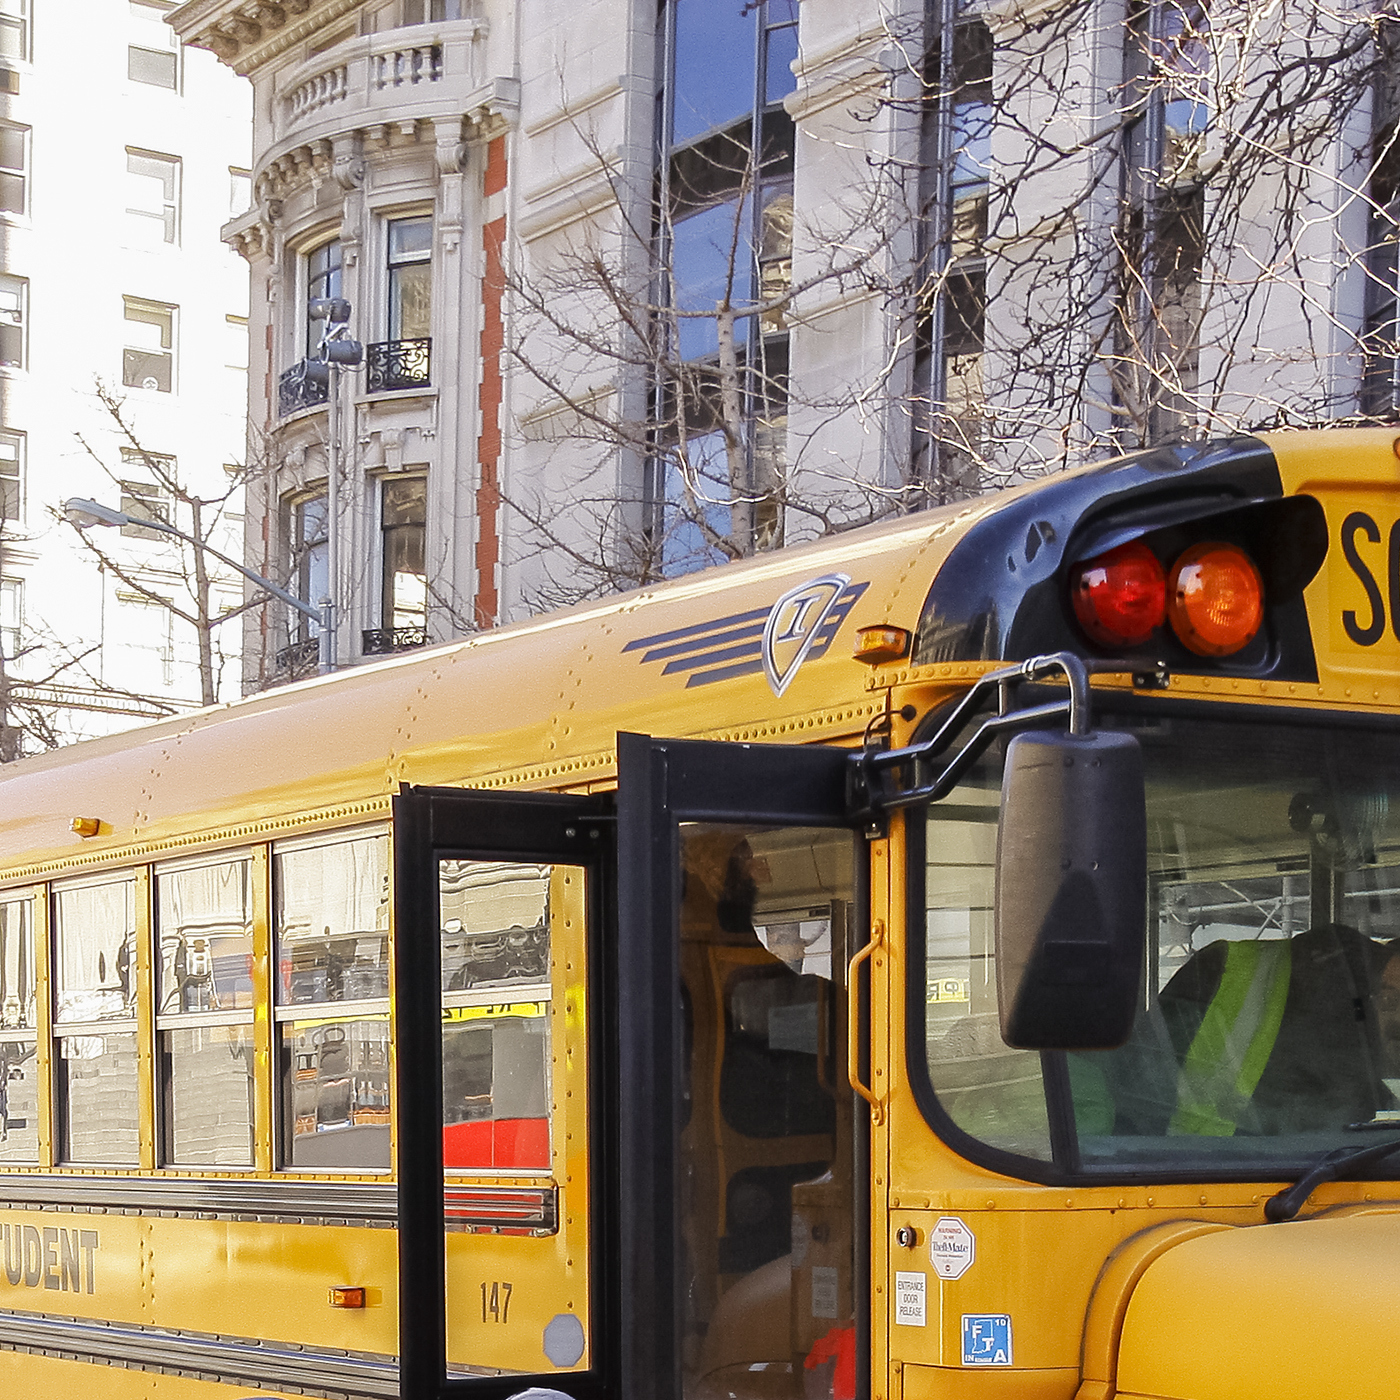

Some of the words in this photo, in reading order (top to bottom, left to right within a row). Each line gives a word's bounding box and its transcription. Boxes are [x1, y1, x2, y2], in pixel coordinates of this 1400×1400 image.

[898, 1280, 924, 1291] ENTRANCE
[480, 1281, 513, 1325] 147
[903, 1293, 919, 1304] DOOR
[899, 1305, 922, 1316] RELEASE
[995, 1318, 1007, 1326] 10
